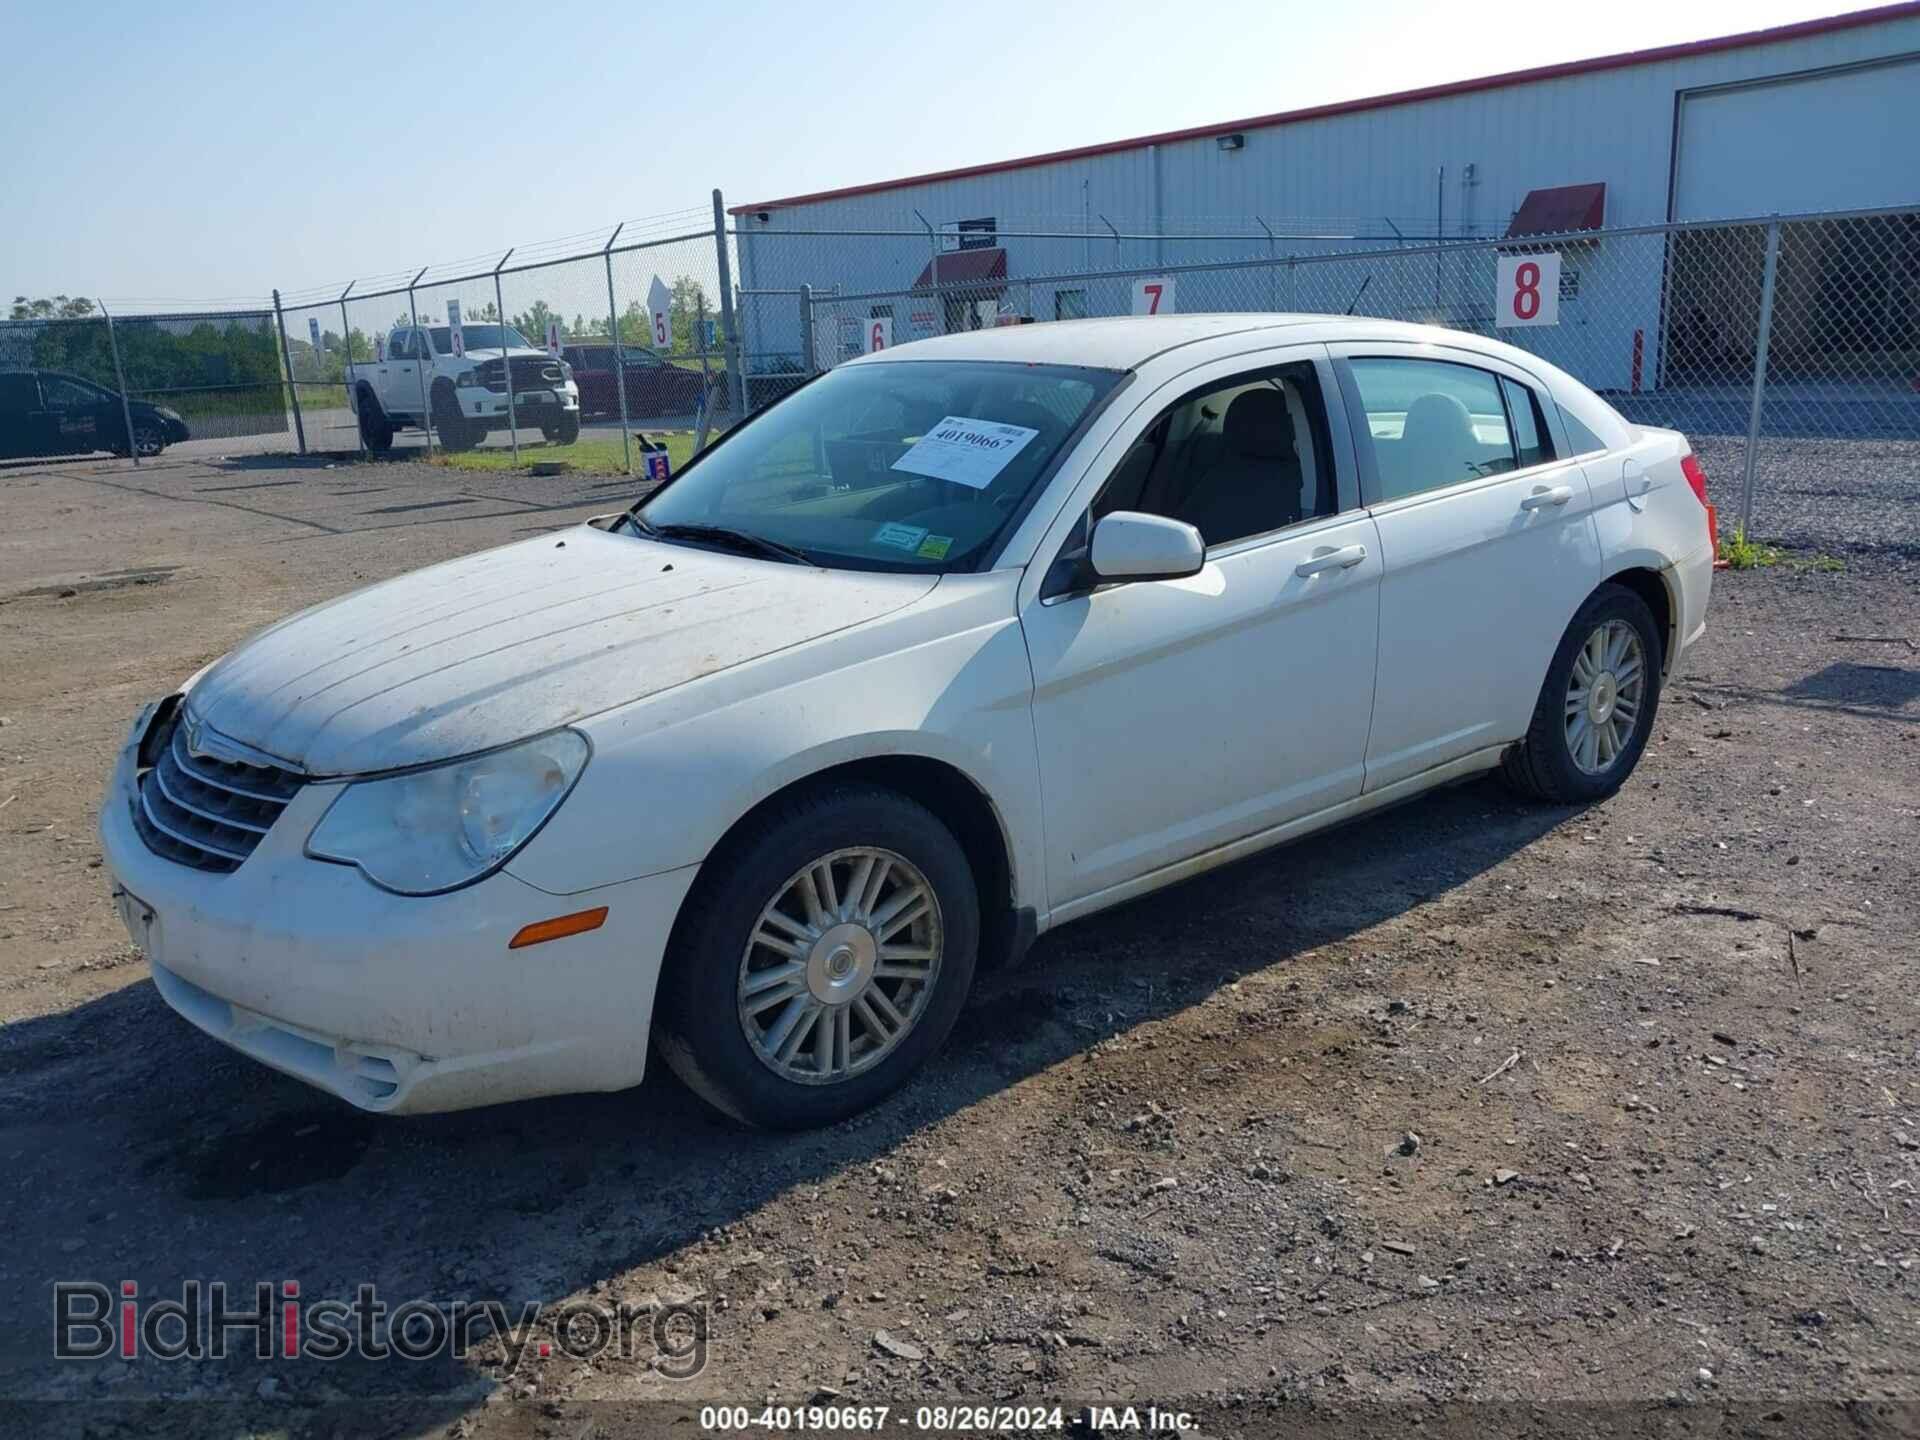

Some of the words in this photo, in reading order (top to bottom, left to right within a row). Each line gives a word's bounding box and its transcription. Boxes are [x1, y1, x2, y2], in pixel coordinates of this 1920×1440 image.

[1144, 284, 1163, 316] 7
[1513, 262, 1541, 320] 8
[655, 312, 666, 344] 5
[871, 322, 884, 352] 6
[936, 428, 1014, 450] 40190667
